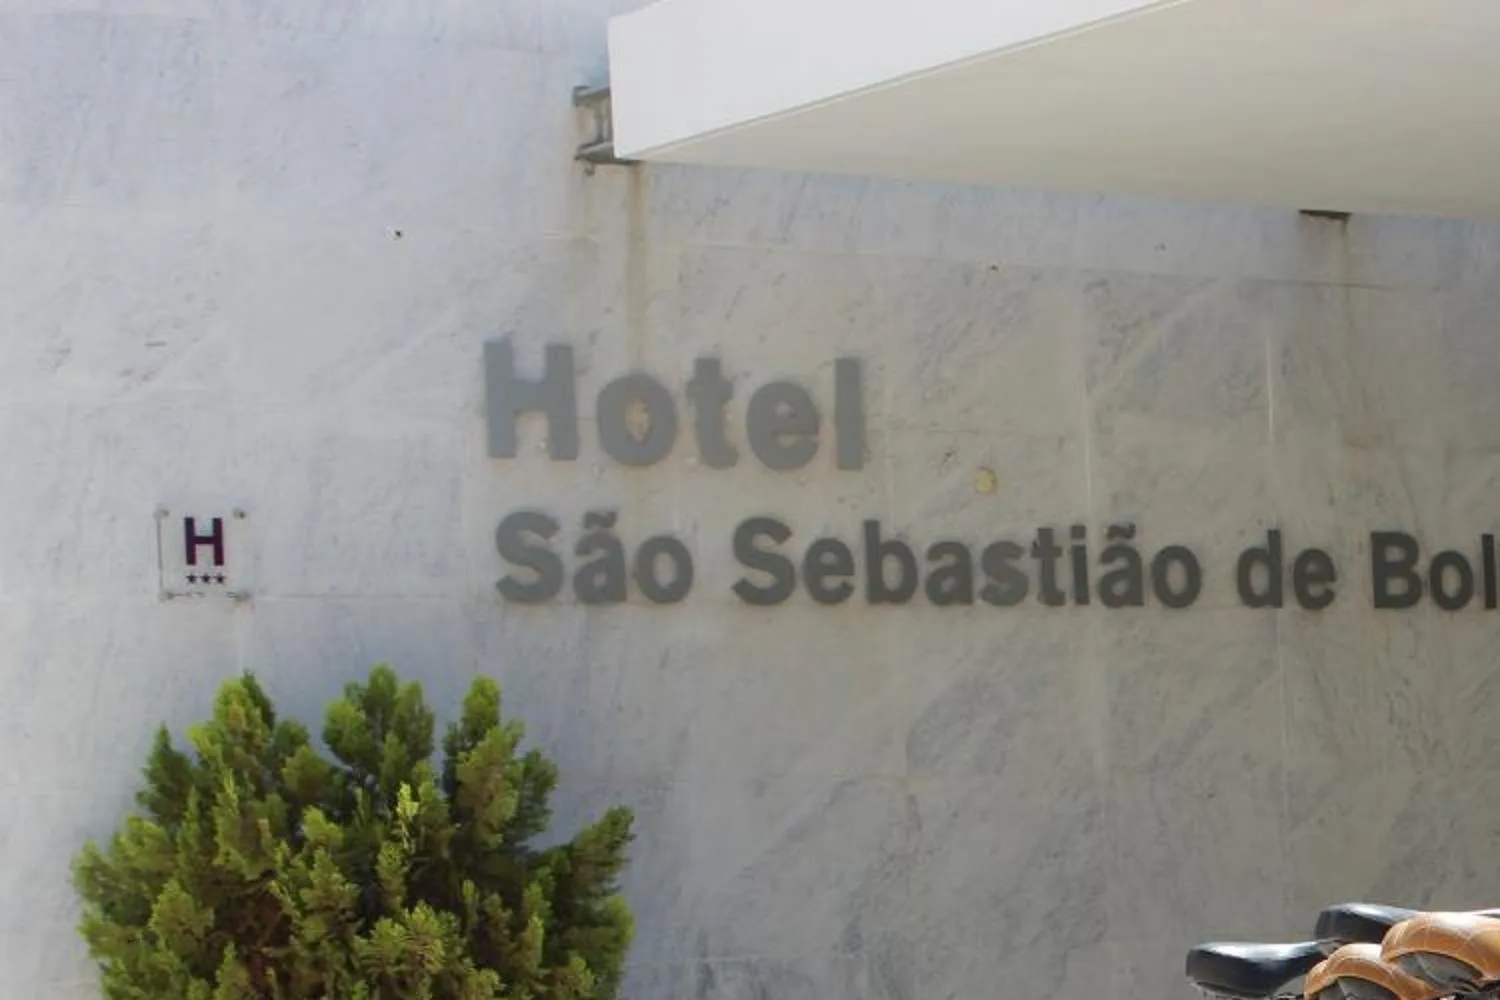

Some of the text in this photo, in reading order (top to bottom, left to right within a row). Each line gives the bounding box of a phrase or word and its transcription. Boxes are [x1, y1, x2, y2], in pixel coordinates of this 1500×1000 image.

[483, 340, 865, 471] Hotel
[184, 516, 224, 566] H
[494, 511, 694, 605] São
[732, 517, 1203, 608] Sebastião
[1237, 529, 1336, 609] de
